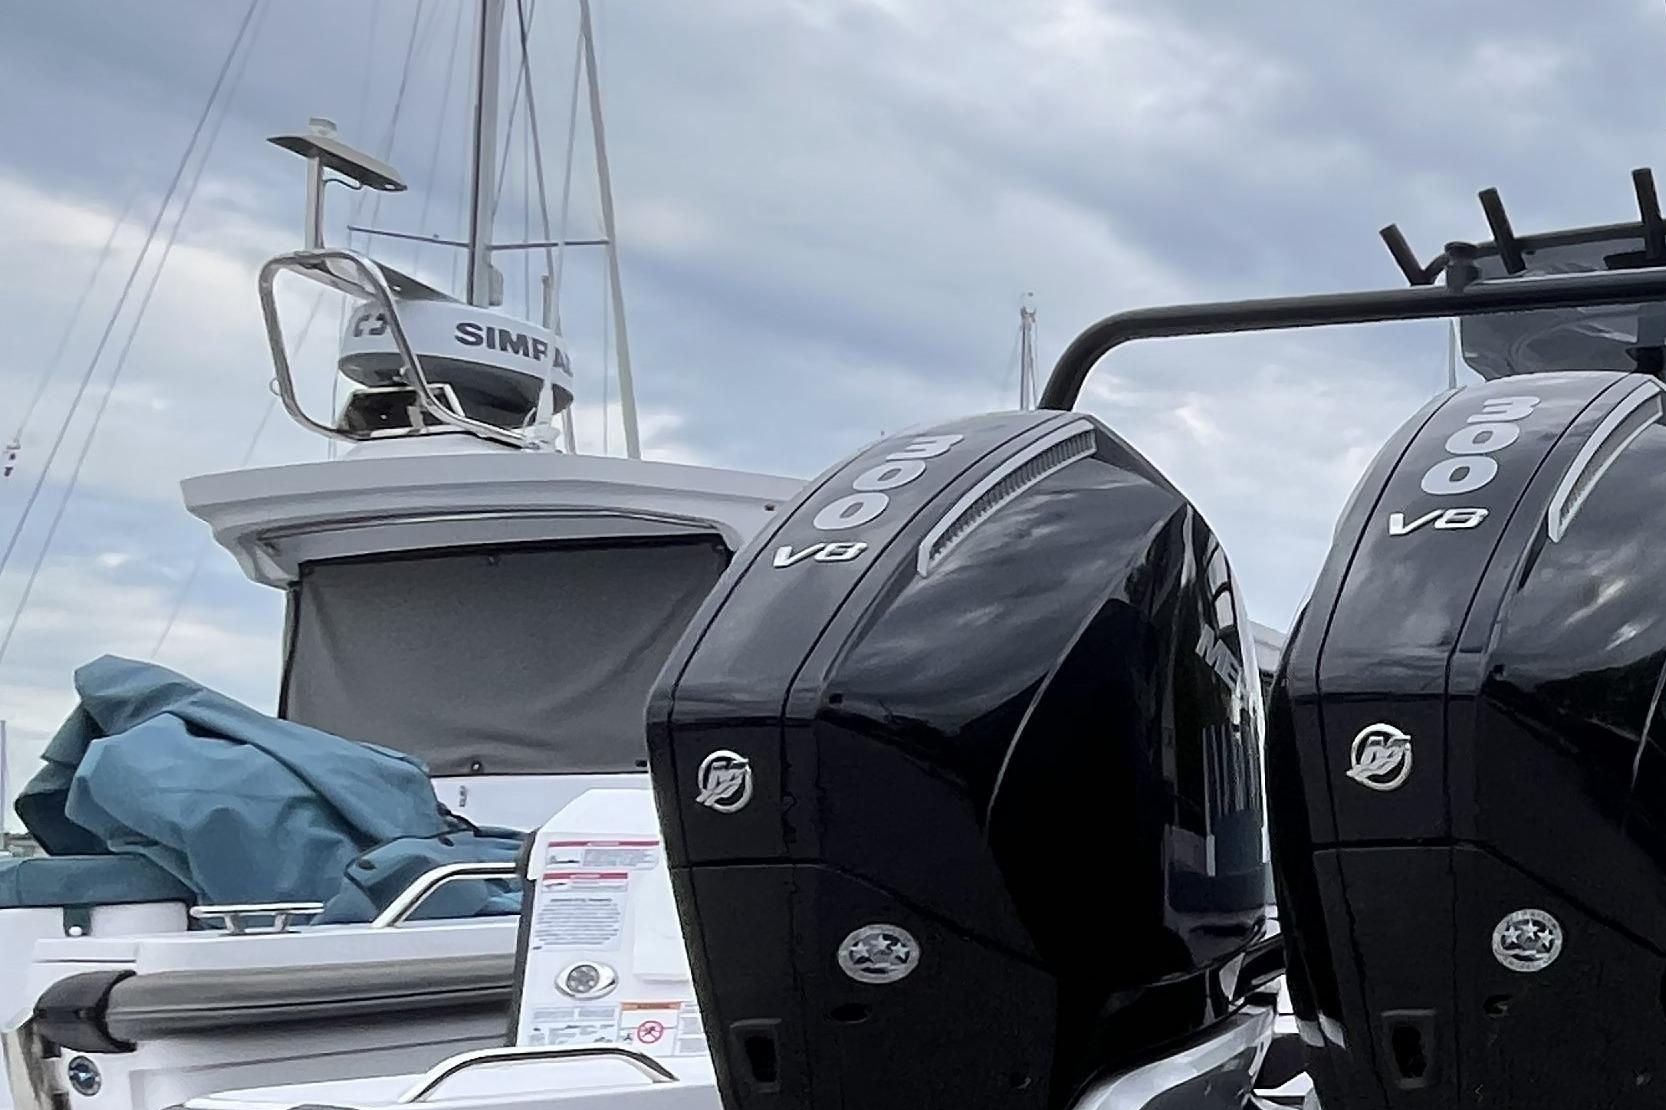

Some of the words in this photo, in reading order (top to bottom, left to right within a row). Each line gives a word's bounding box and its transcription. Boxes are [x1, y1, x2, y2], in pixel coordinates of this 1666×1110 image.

[455, 322, 574, 378] SIMRA
[1421, 396, 1540, 496] 300
[813, 434, 965, 531] 300
[1389, 507, 1490, 536] V8
[773, 542, 868, 568] V8
